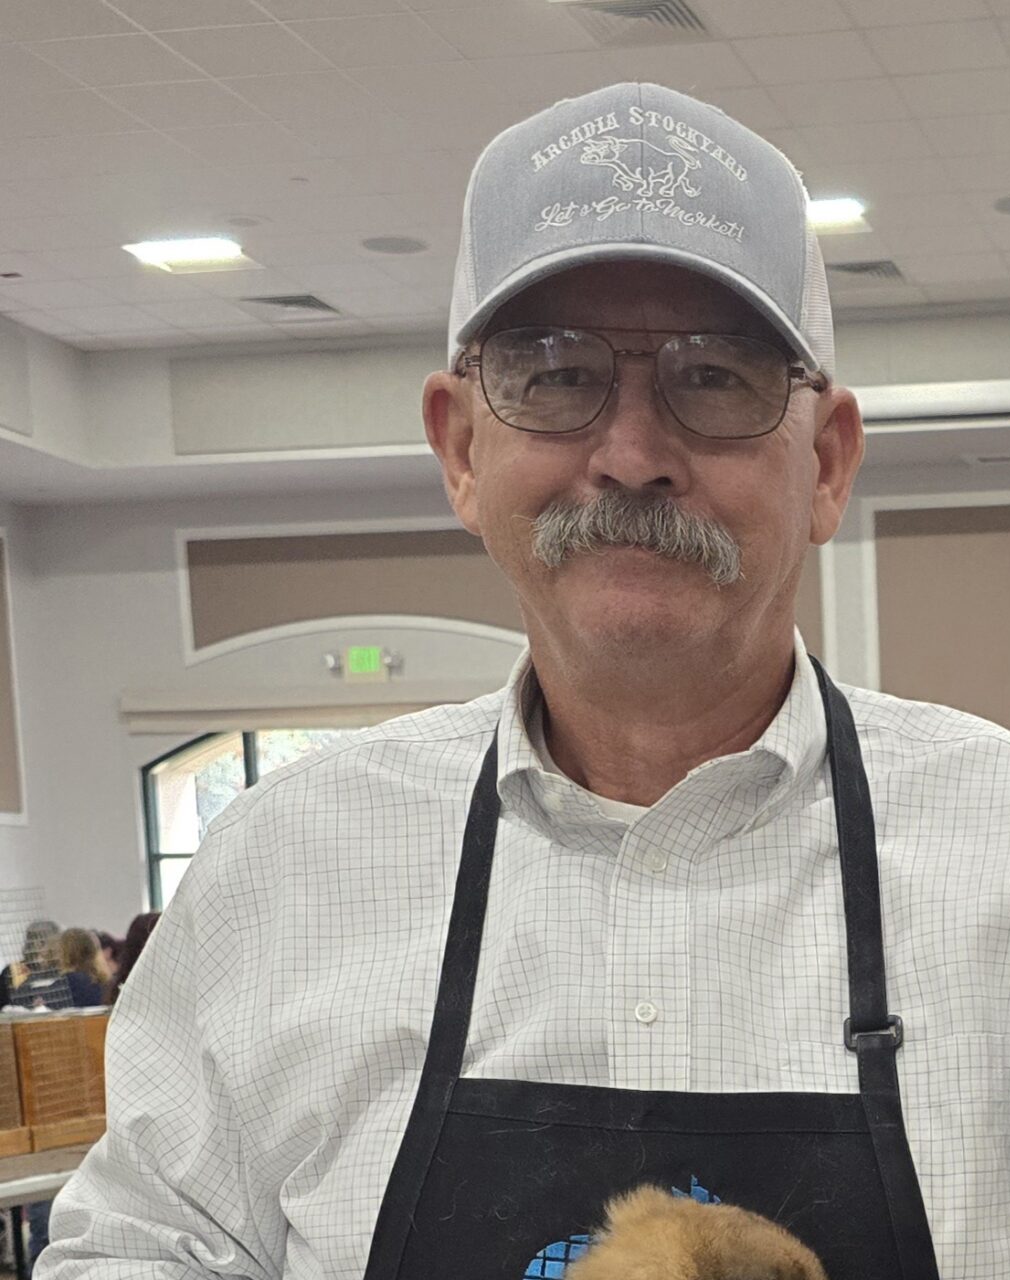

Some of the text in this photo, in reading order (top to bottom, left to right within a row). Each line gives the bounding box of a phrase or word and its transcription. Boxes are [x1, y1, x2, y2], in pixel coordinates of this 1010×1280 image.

[530, 106, 749, 182] ARCADIA STOCKYARD
[592, 196, 632, 222] Go
[633, 197, 660, 213] to
[656, 198, 745, 244] Market!
